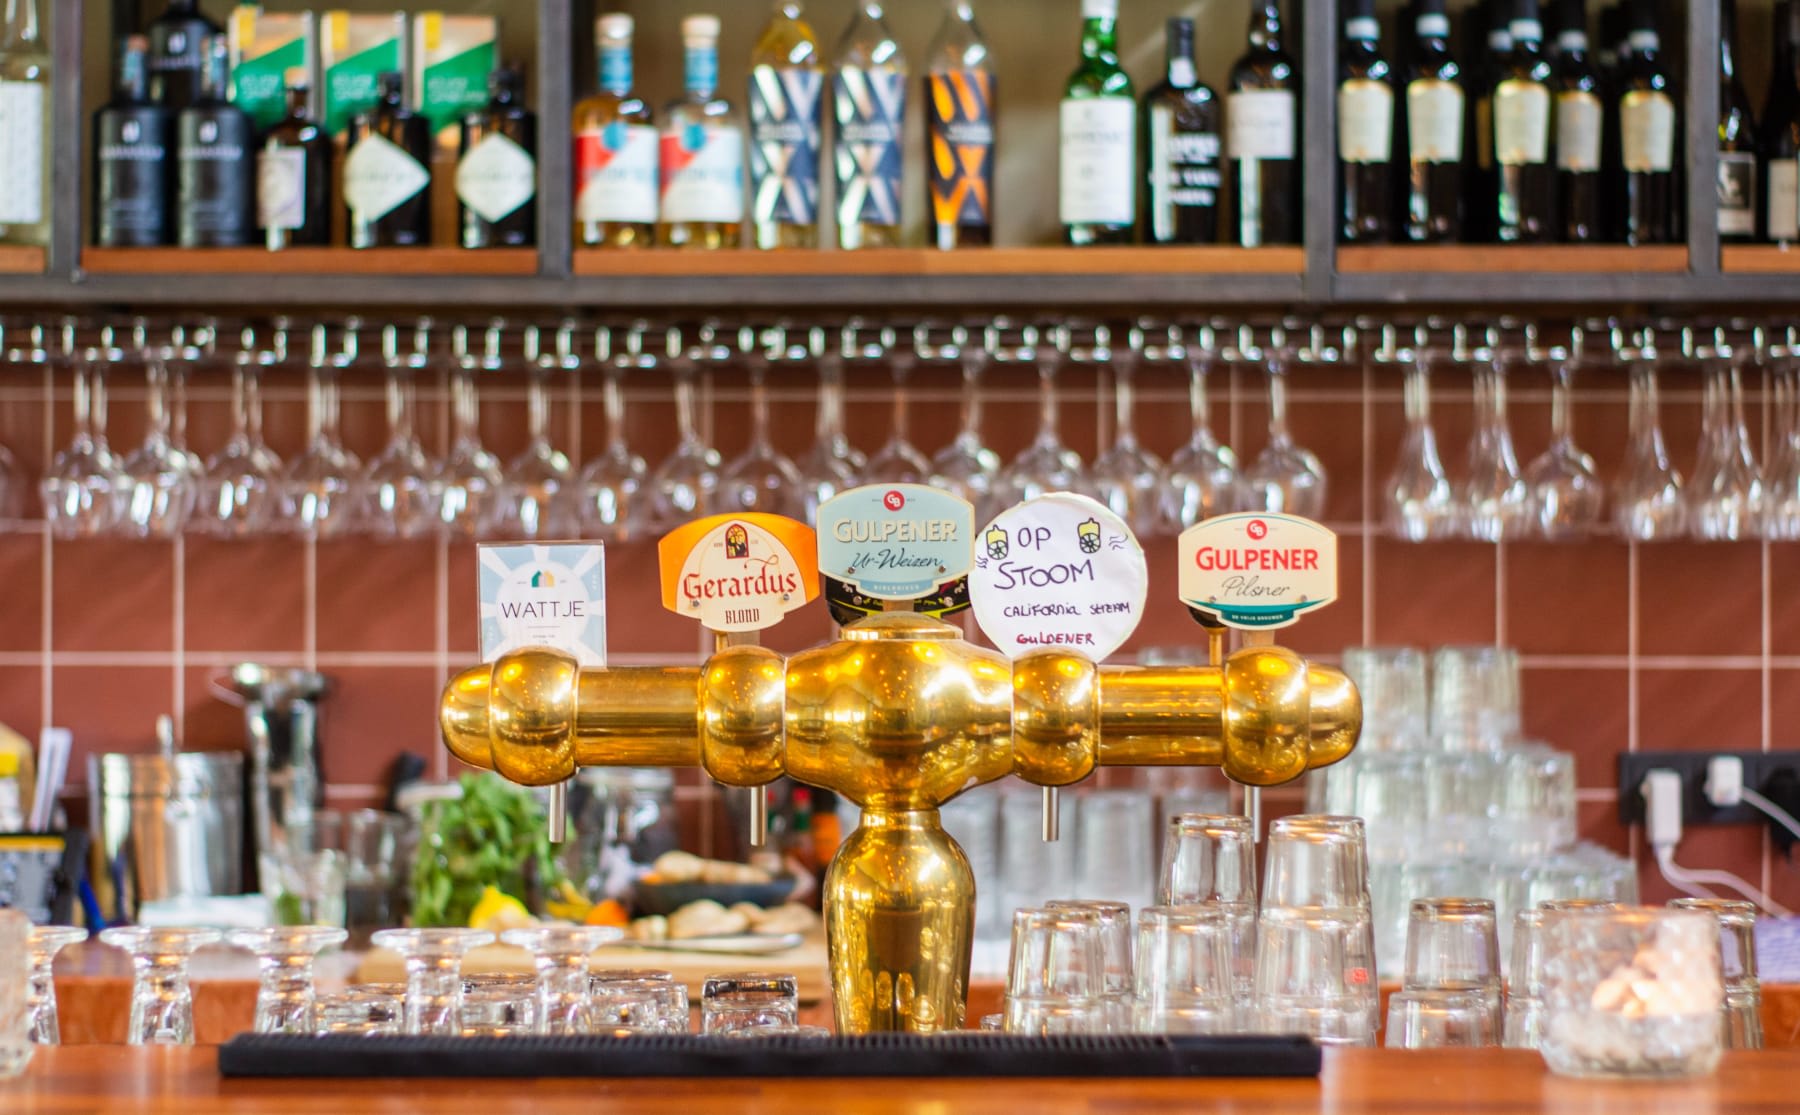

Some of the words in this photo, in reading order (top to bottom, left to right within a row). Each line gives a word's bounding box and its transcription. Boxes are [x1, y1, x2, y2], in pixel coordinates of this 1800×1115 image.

[833, 518, 958, 543] GULPENER
[1017, 526, 1052, 551] OP
[851, 547, 944, 569] Ur-Weizen
[1195, 546, 1319, 571] GULPENER
[683, 562, 797, 600] Gerardus
[993, 559, 1095, 590] STOOM
[1221, 575, 1291, 597] Pilsner
[501, 600, 585, 619] WATTJE
[725, 608, 760, 625] BLOND
